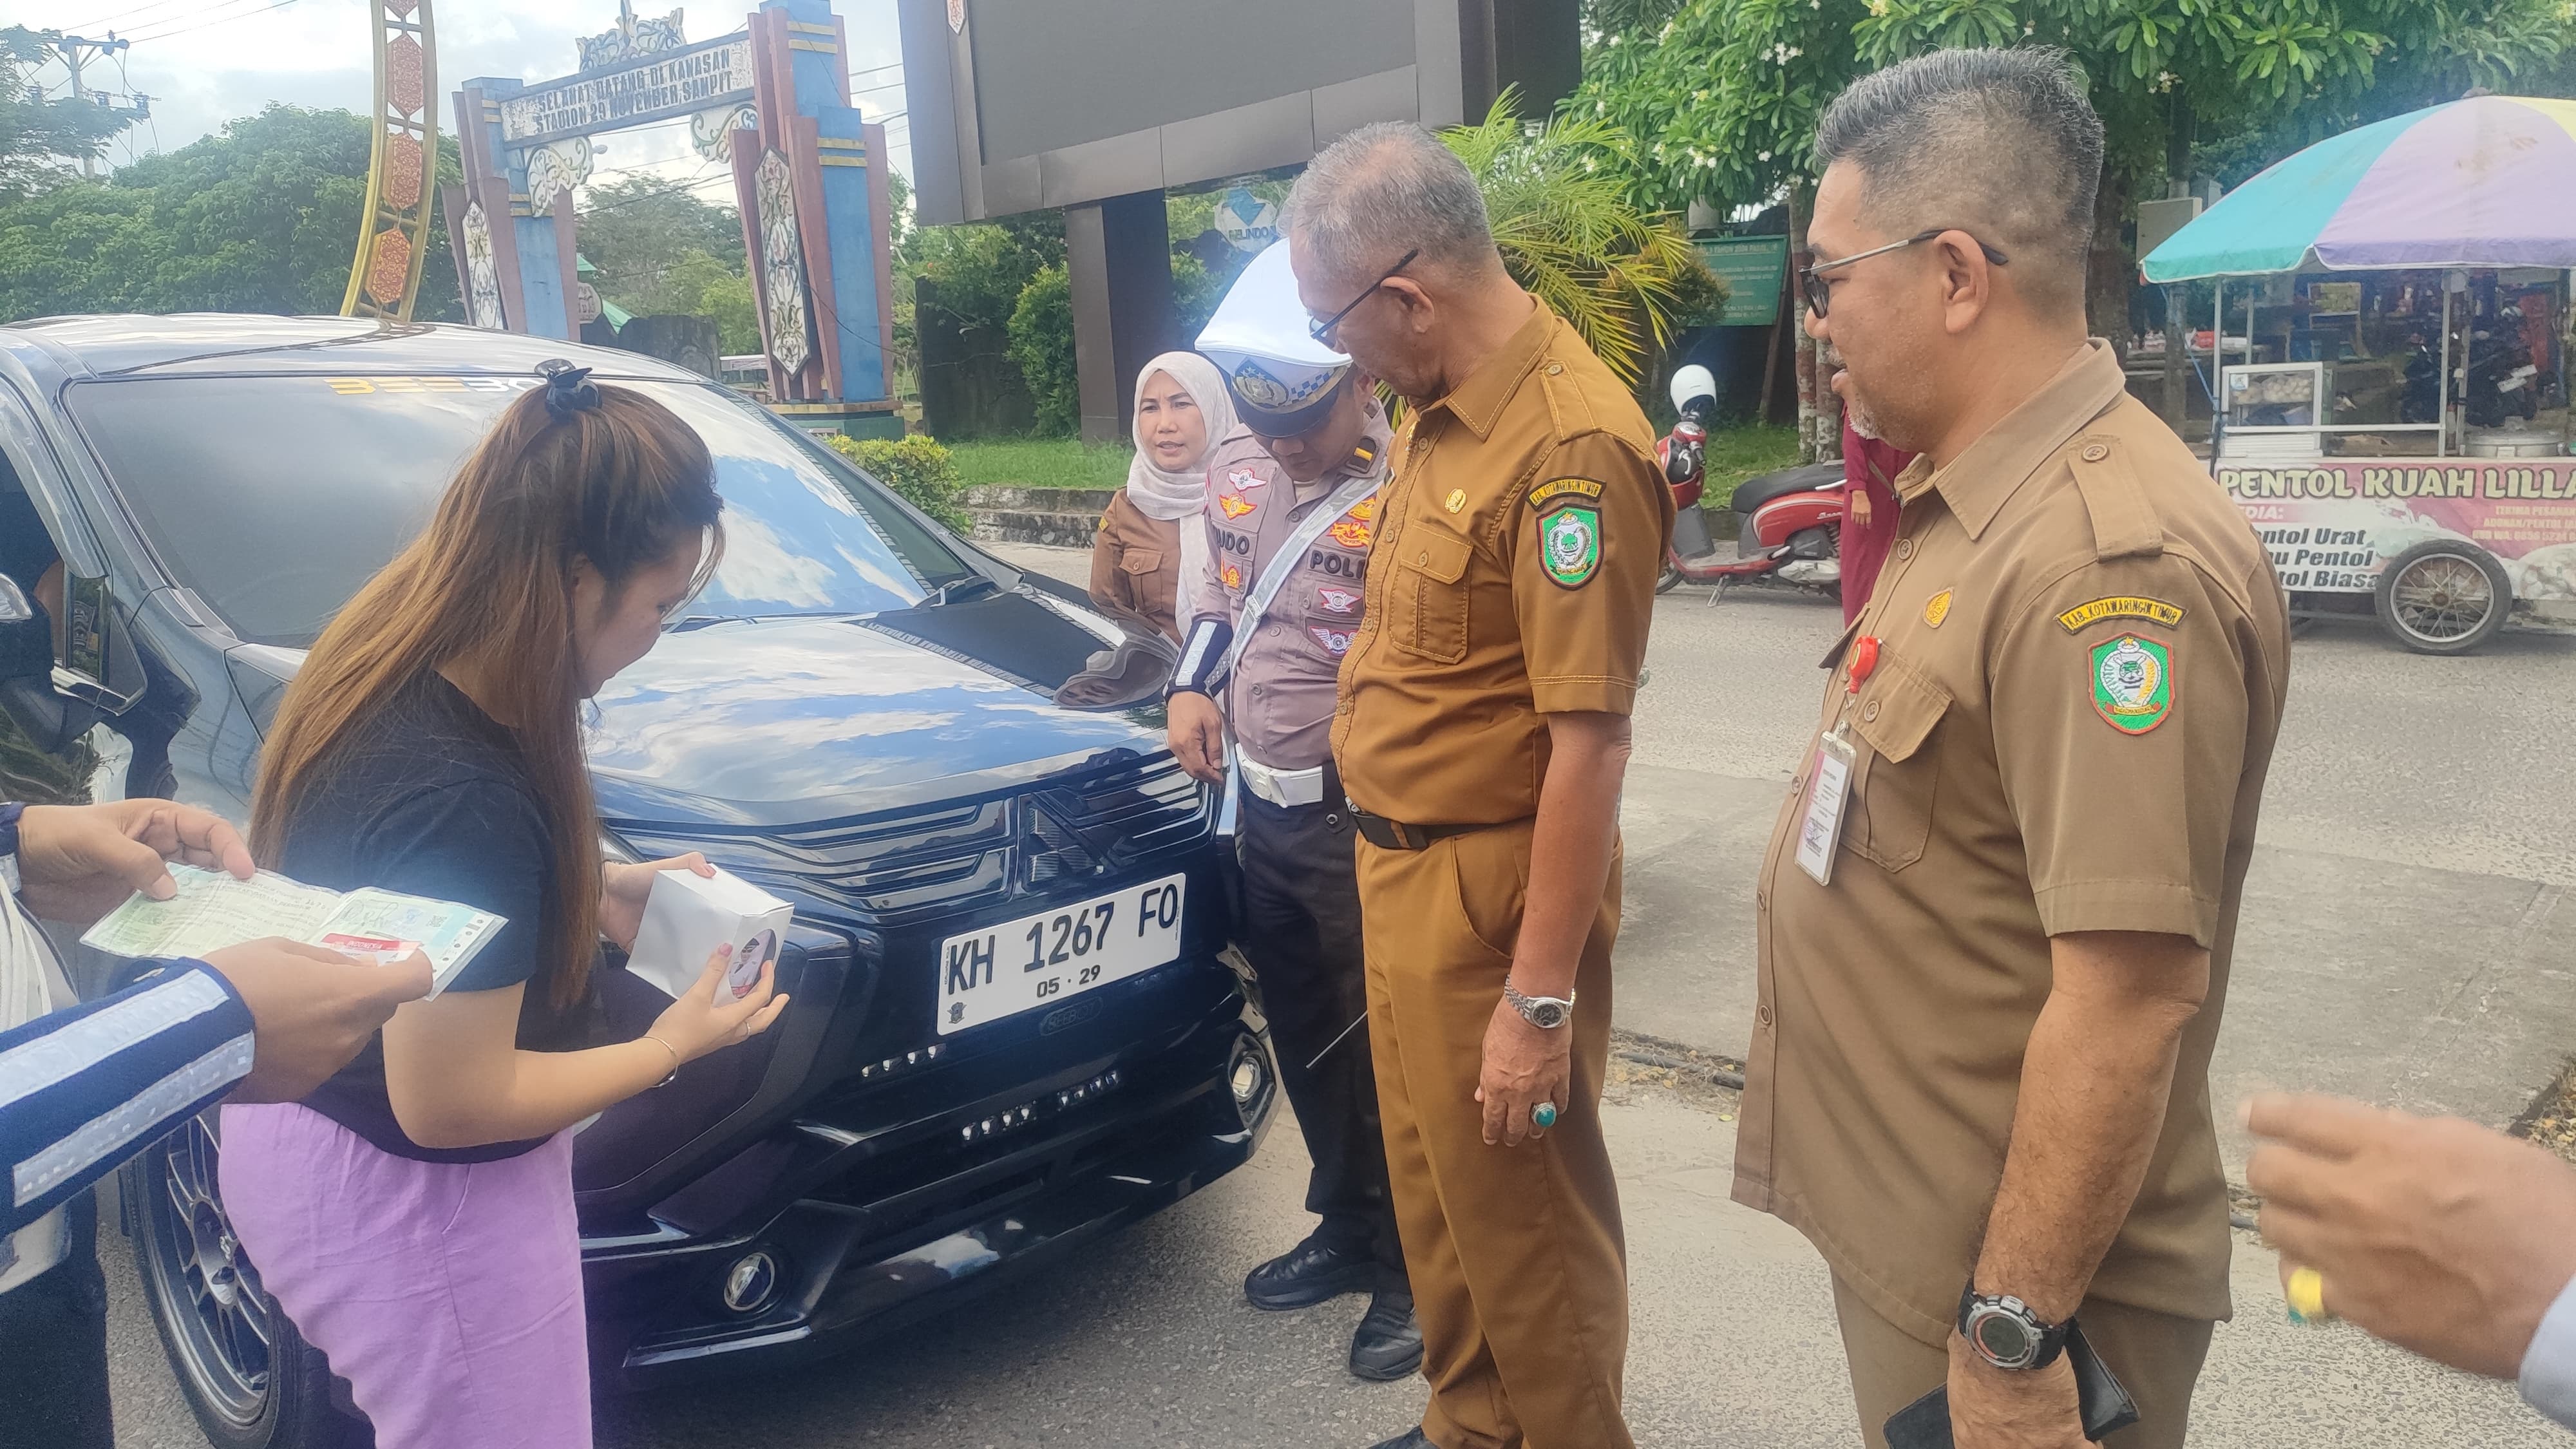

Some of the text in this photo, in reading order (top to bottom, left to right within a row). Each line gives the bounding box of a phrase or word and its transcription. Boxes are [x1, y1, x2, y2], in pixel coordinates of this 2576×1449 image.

[538, 48, 730, 112] SELAMAT DATANG DI KAWASAN
[533, 106, 587, 133] STADION
[590, 101, 607, 122] 29
[682, 70, 732, 102] SAMPIT
[2218, 468, 2355, 499] PENTOL
[2361, 468, 2476, 499] KUAH
[2239, 506, 2284, 520] DIA:
[1215, 527, 1249, 555] NDO
[2257, 528, 2366, 545] ntol Urat
[2295, 549, 2374, 566] Pentol
[2278, 570, 2381, 587] tol Biasa
[2064, 600, 2178, 627] KAB. KOTAWARINGIN TIMUR
[948, 934, 995, 995] KH
[1024, 901, 1114, 972] 1267
[1138, 884, 1179, 937] FO
[1036, 976, 1060, 998] 05
[1079, 965, 1101, 985] 29
